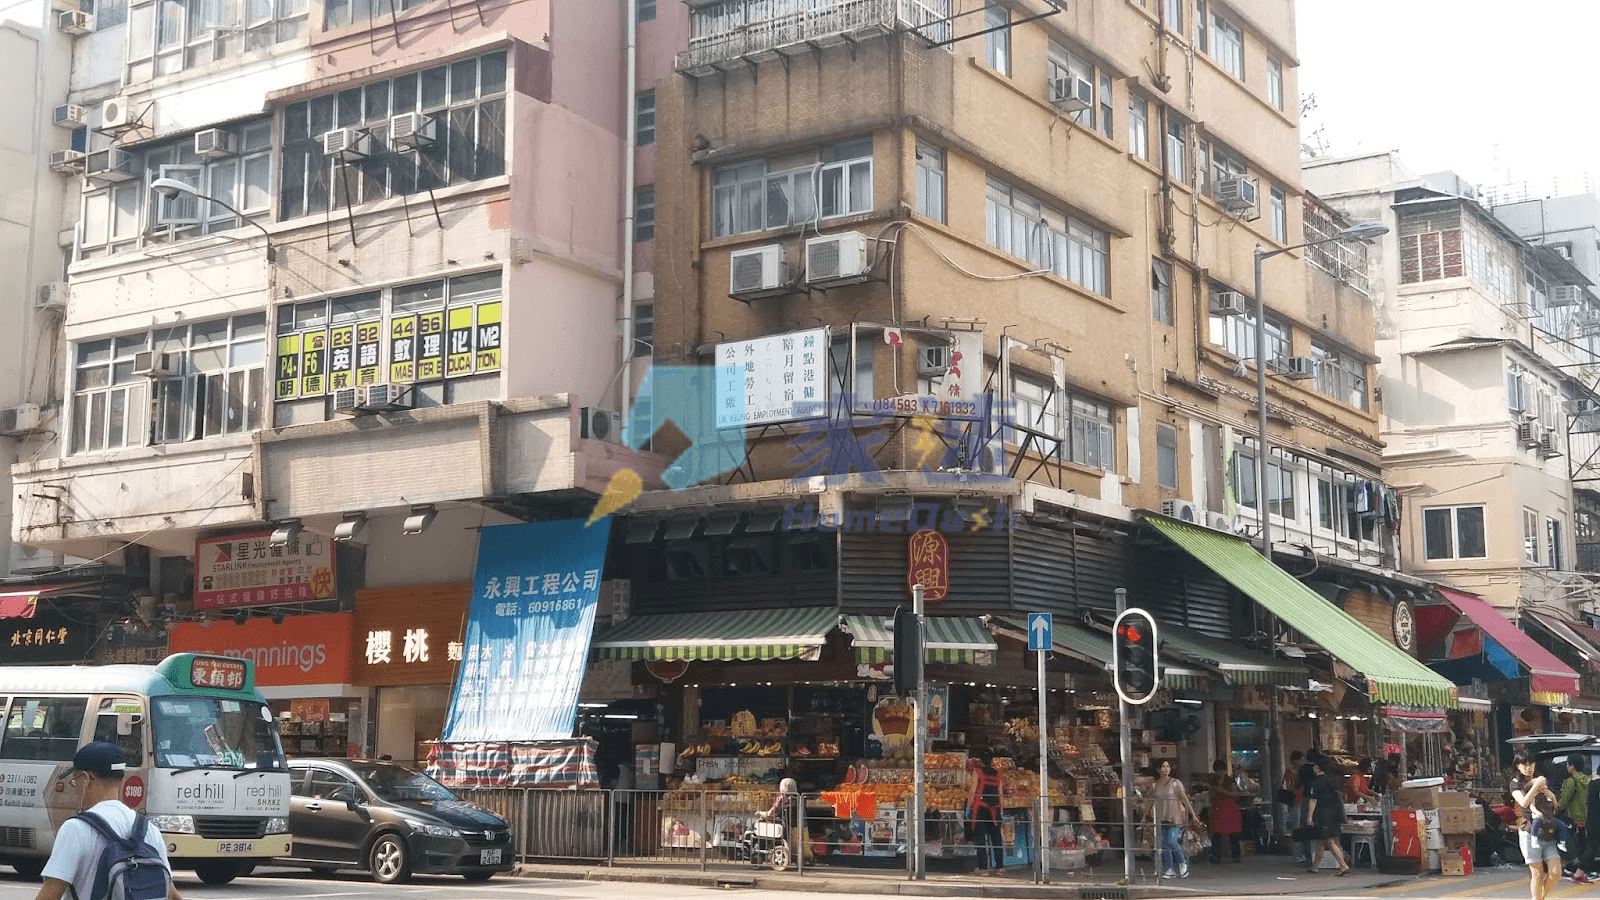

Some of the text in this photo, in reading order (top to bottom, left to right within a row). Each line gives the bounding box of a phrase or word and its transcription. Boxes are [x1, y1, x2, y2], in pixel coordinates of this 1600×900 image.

[480, 325, 500, 348] M2
[754, 406, 793, 419] EMPLOYMENT
[796, 403, 822, 415] AGENCY
[213, 562, 247, 573] STARLINK
[312, 568, 332, 595] 快
[483, 569, 599, 600] 永興工程公司
[528, 598, 582, 614] 60916861
[10, 626, 68, 647] 北京同仁堂
[224, 640, 326, 671] mannings
[365, 629, 429, 665] 櫻桃
[177, 783, 282, 799] red hill red hill
[257, 798, 281, 806] SHAKE
[220, 842, 253, 853] PE 3814
